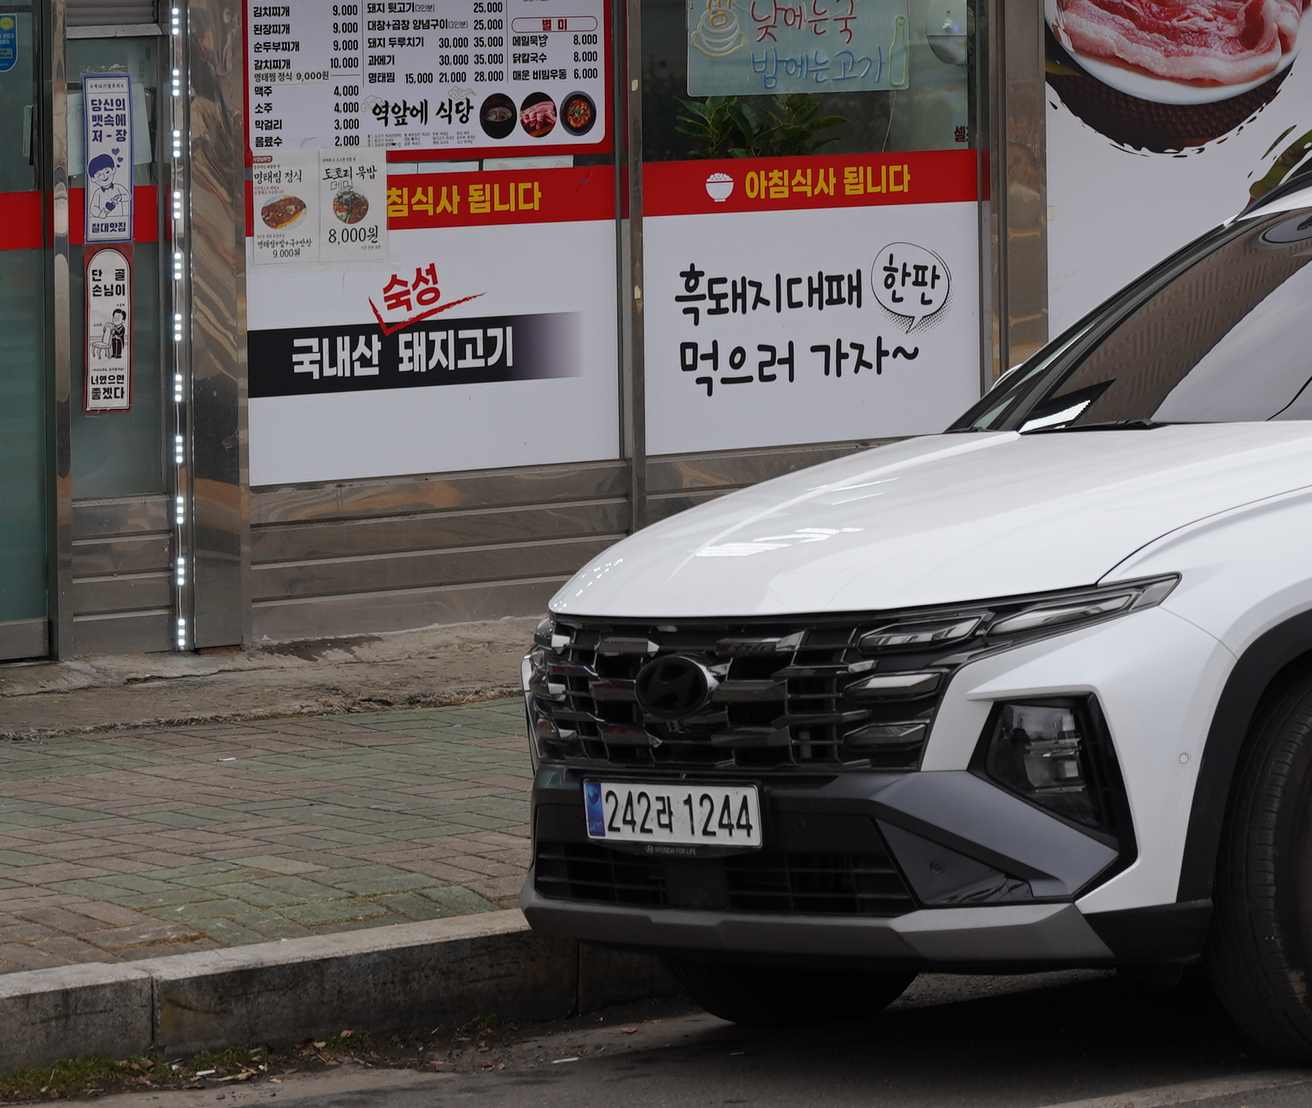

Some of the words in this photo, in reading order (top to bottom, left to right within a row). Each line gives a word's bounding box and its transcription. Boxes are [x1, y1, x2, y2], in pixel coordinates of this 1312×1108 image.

[253, 6, 290, 18] 김치찌개
[332, 5, 358, 16] 9,000
[367, 3, 385, 13] 돼지
[473, 2, 503, 13] 25,000
[253, 24, 290, 35] 된장찌개
[333, 22, 358, 34] 9,000
[474, 19, 503, 30] 25,000
[368, 37, 385, 48] 돼지
[388, 37, 424, 48] 두루치기
[438, 37, 468, 49] 30,000
[474, 36, 503, 48] 35,000
[573, 34, 598, 45] 8,000
[254, 41, 300, 53] 순두부찌개
[333, 40, 359, 51] 9,000
[254, 59, 291, 70] 갈치찌개
[330, 57, 359, 69] 10,000
[439, 54, 468, 66] 30,000
[474, 53, 503, 65] 35,000
[512, 52, 547, 64] 닭칼국수
[573, 51, 598, 63] 8,000
[254, 72, 276, 82] 명태찜
[278, 72, 292, 82] 정식
[296, 71, 329, 82] 9,000원
[368, 72, 395, 83] 명태찜
[405, 72, 433, 84] 15,000
[439, 71, 466, 83] 21,000
[474, 70, 504, 82] 28,000
[512, 70, 530, 81] 매운
[533, 69, 567, 80] 비빔우동
[574, 68, 598, 79] 6,000
[254, 86, 273, 97] 맥주
[334, 85, 359, 96] 4,000
[90, 98, 126, 111] 당신의
[255, 103, 273, 114] 소주
[334, 102, 359, 113] 4,000
[372, 99, 428, 127] 역앞에
[435, 97, 474, 125] 식당
[91, 114, 126, 127] 뱃속에
[255, 119, 282, 130] 막걸리
[334, 119, 359, 130] 3,000
[255, 136, 282, 147] 음료수
[335, 135, 360, 147] 2,000
[254, 170, 282, 184] 명태찜
[284, 169, 302, 183] 정식
[355, 165, 377, 180] 묵밥
[745, 167, 836, 199] 아침식사
[843, 164, 910, 196] 됩니다
[468, 182, 541, 213] 됩니다
[92, 222, 126, 233] 절대맛집
[328, 225, 379, 245] 8,000원
[92, 284, 125, 297] 손님이
[382, 262, 441, 312] 숙성
[674, 263, 863, 326] 흑돼지대패
[883, 254, 940, 306] 한판
[292, 335, 381, 380] 국내산
[398, 326, 513, 373] 돼지고기
[679, 340, 795, 397] 먹으러
[810, 336, 919, 377] 가자~
[91, 374, 124, 385] 너였으면
[91, 387, 125, 400] 좋겠다
[605, 790, 673, 833] 242라
[683, 793, 753, 837] 1244
